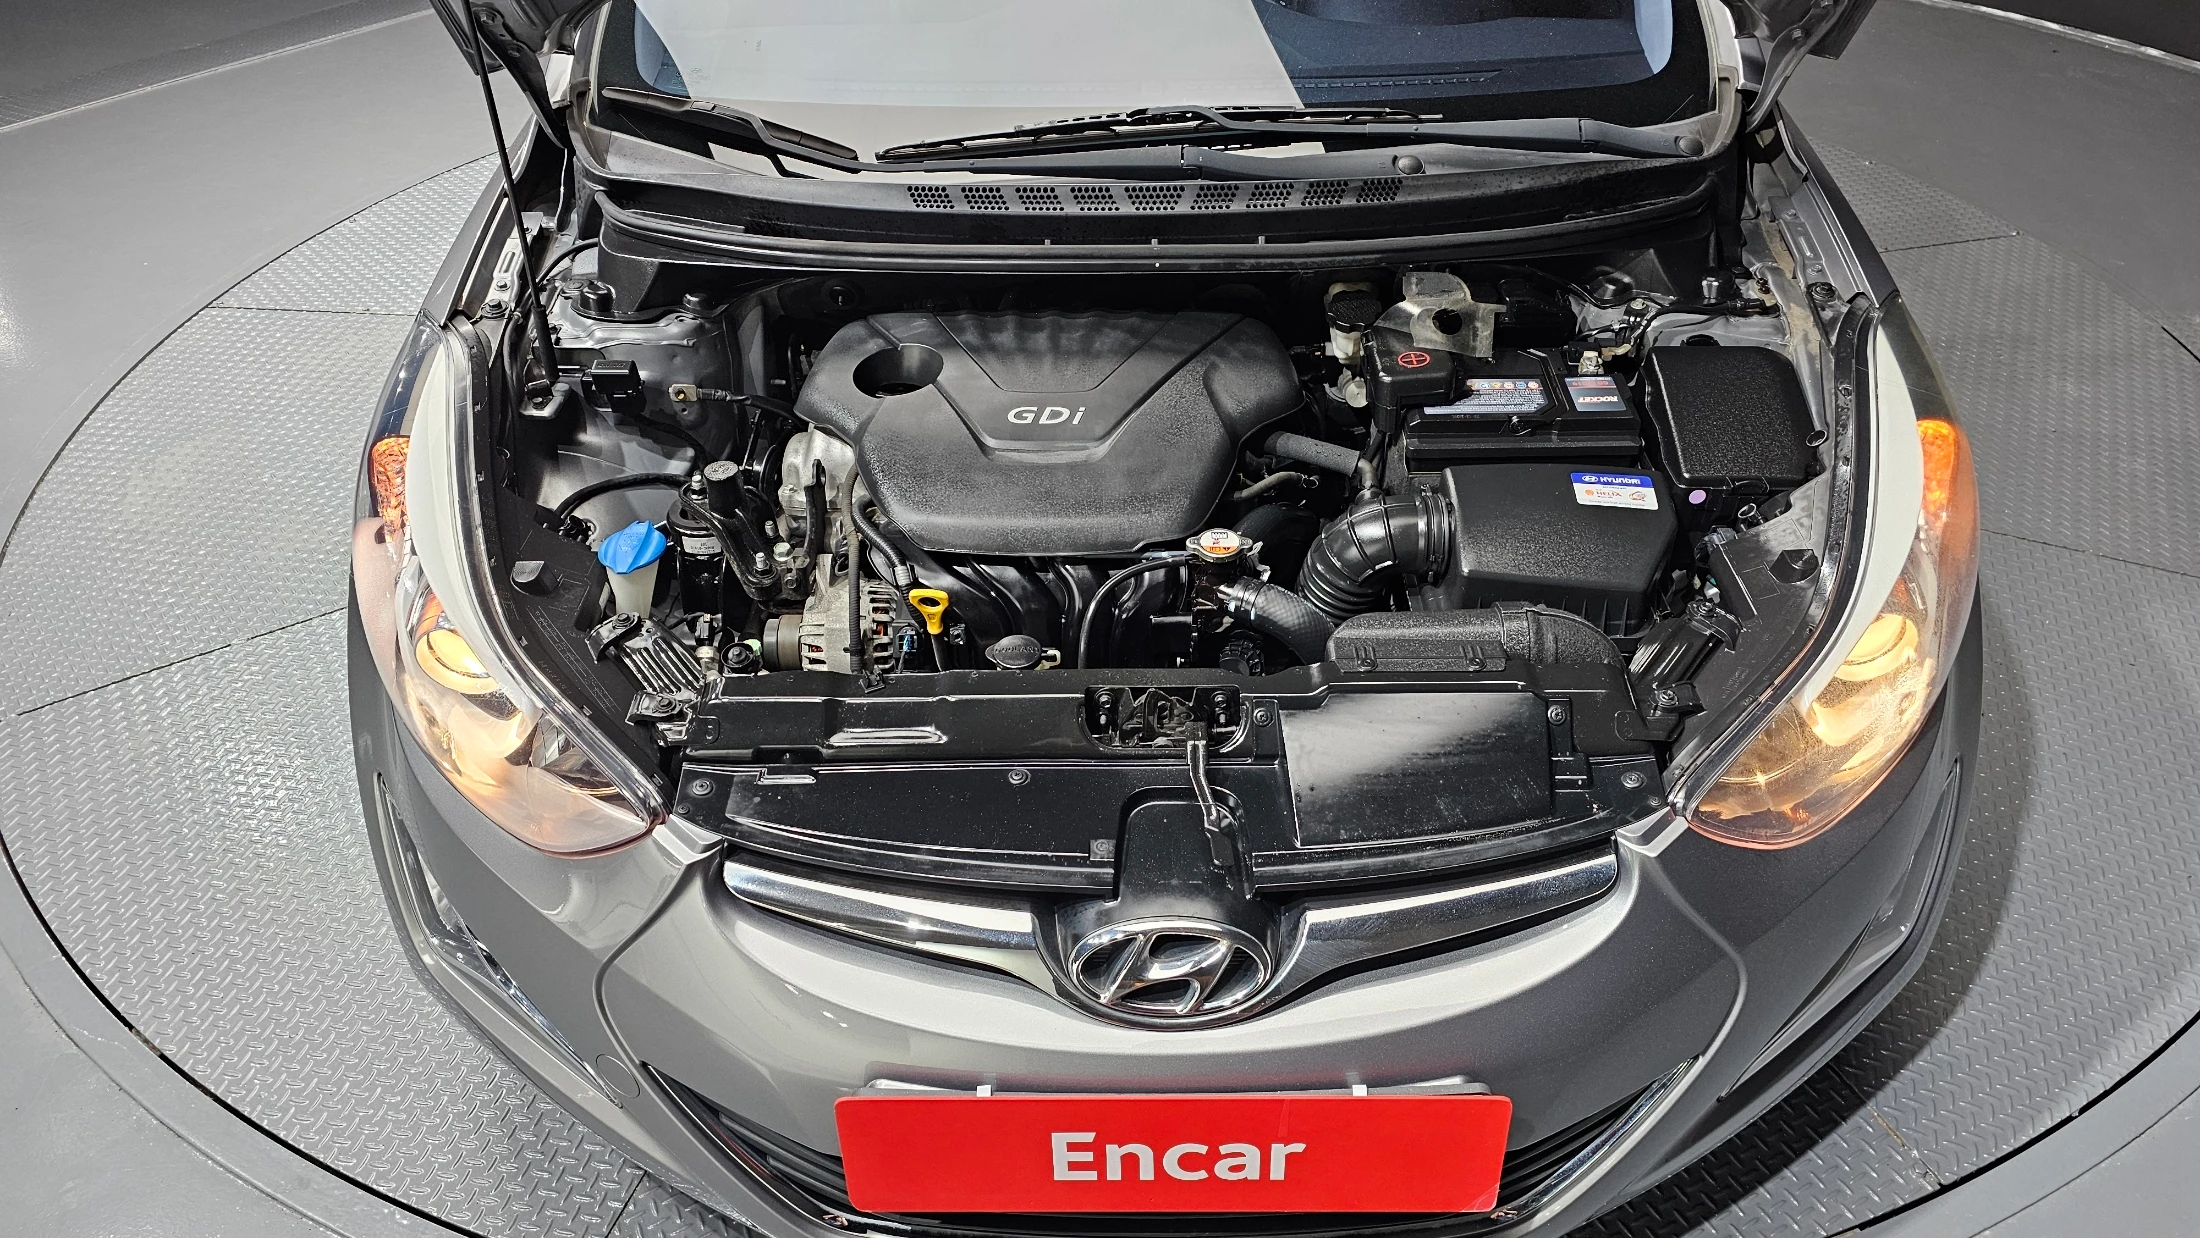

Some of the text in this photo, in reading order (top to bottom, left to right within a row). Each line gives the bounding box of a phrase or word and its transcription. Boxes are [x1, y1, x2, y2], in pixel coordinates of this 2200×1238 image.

[1577, 395, 1619, 403] ROCKET
[1007, 406, 1087, 425] GDi
[1600, 476, 1641, 485] HYUNDAI
[1051, 1132, 1307, 1181] Encar
